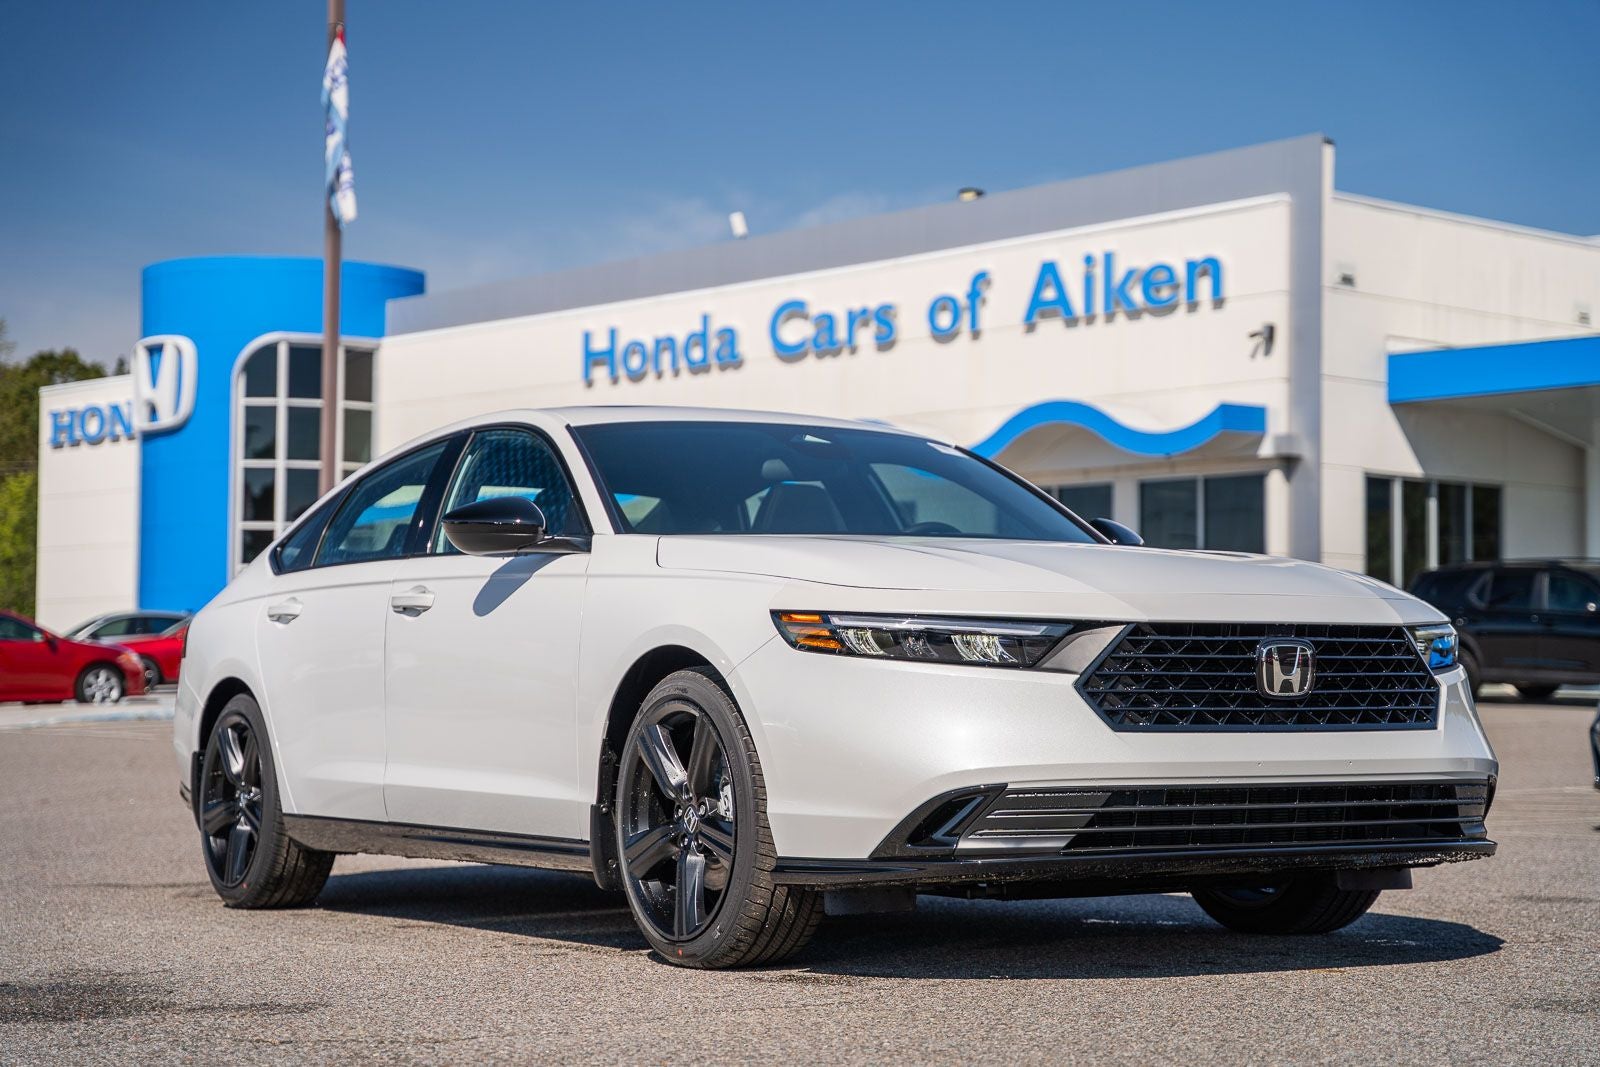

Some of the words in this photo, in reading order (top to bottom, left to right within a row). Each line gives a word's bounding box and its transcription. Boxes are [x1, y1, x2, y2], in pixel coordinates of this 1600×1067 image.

[582, 314, 741, 384] Honda
[768, 299, 897, 360] Cars
[926, 270, 990, 339] of
[1023, 251, 1224, 328] Aiken
